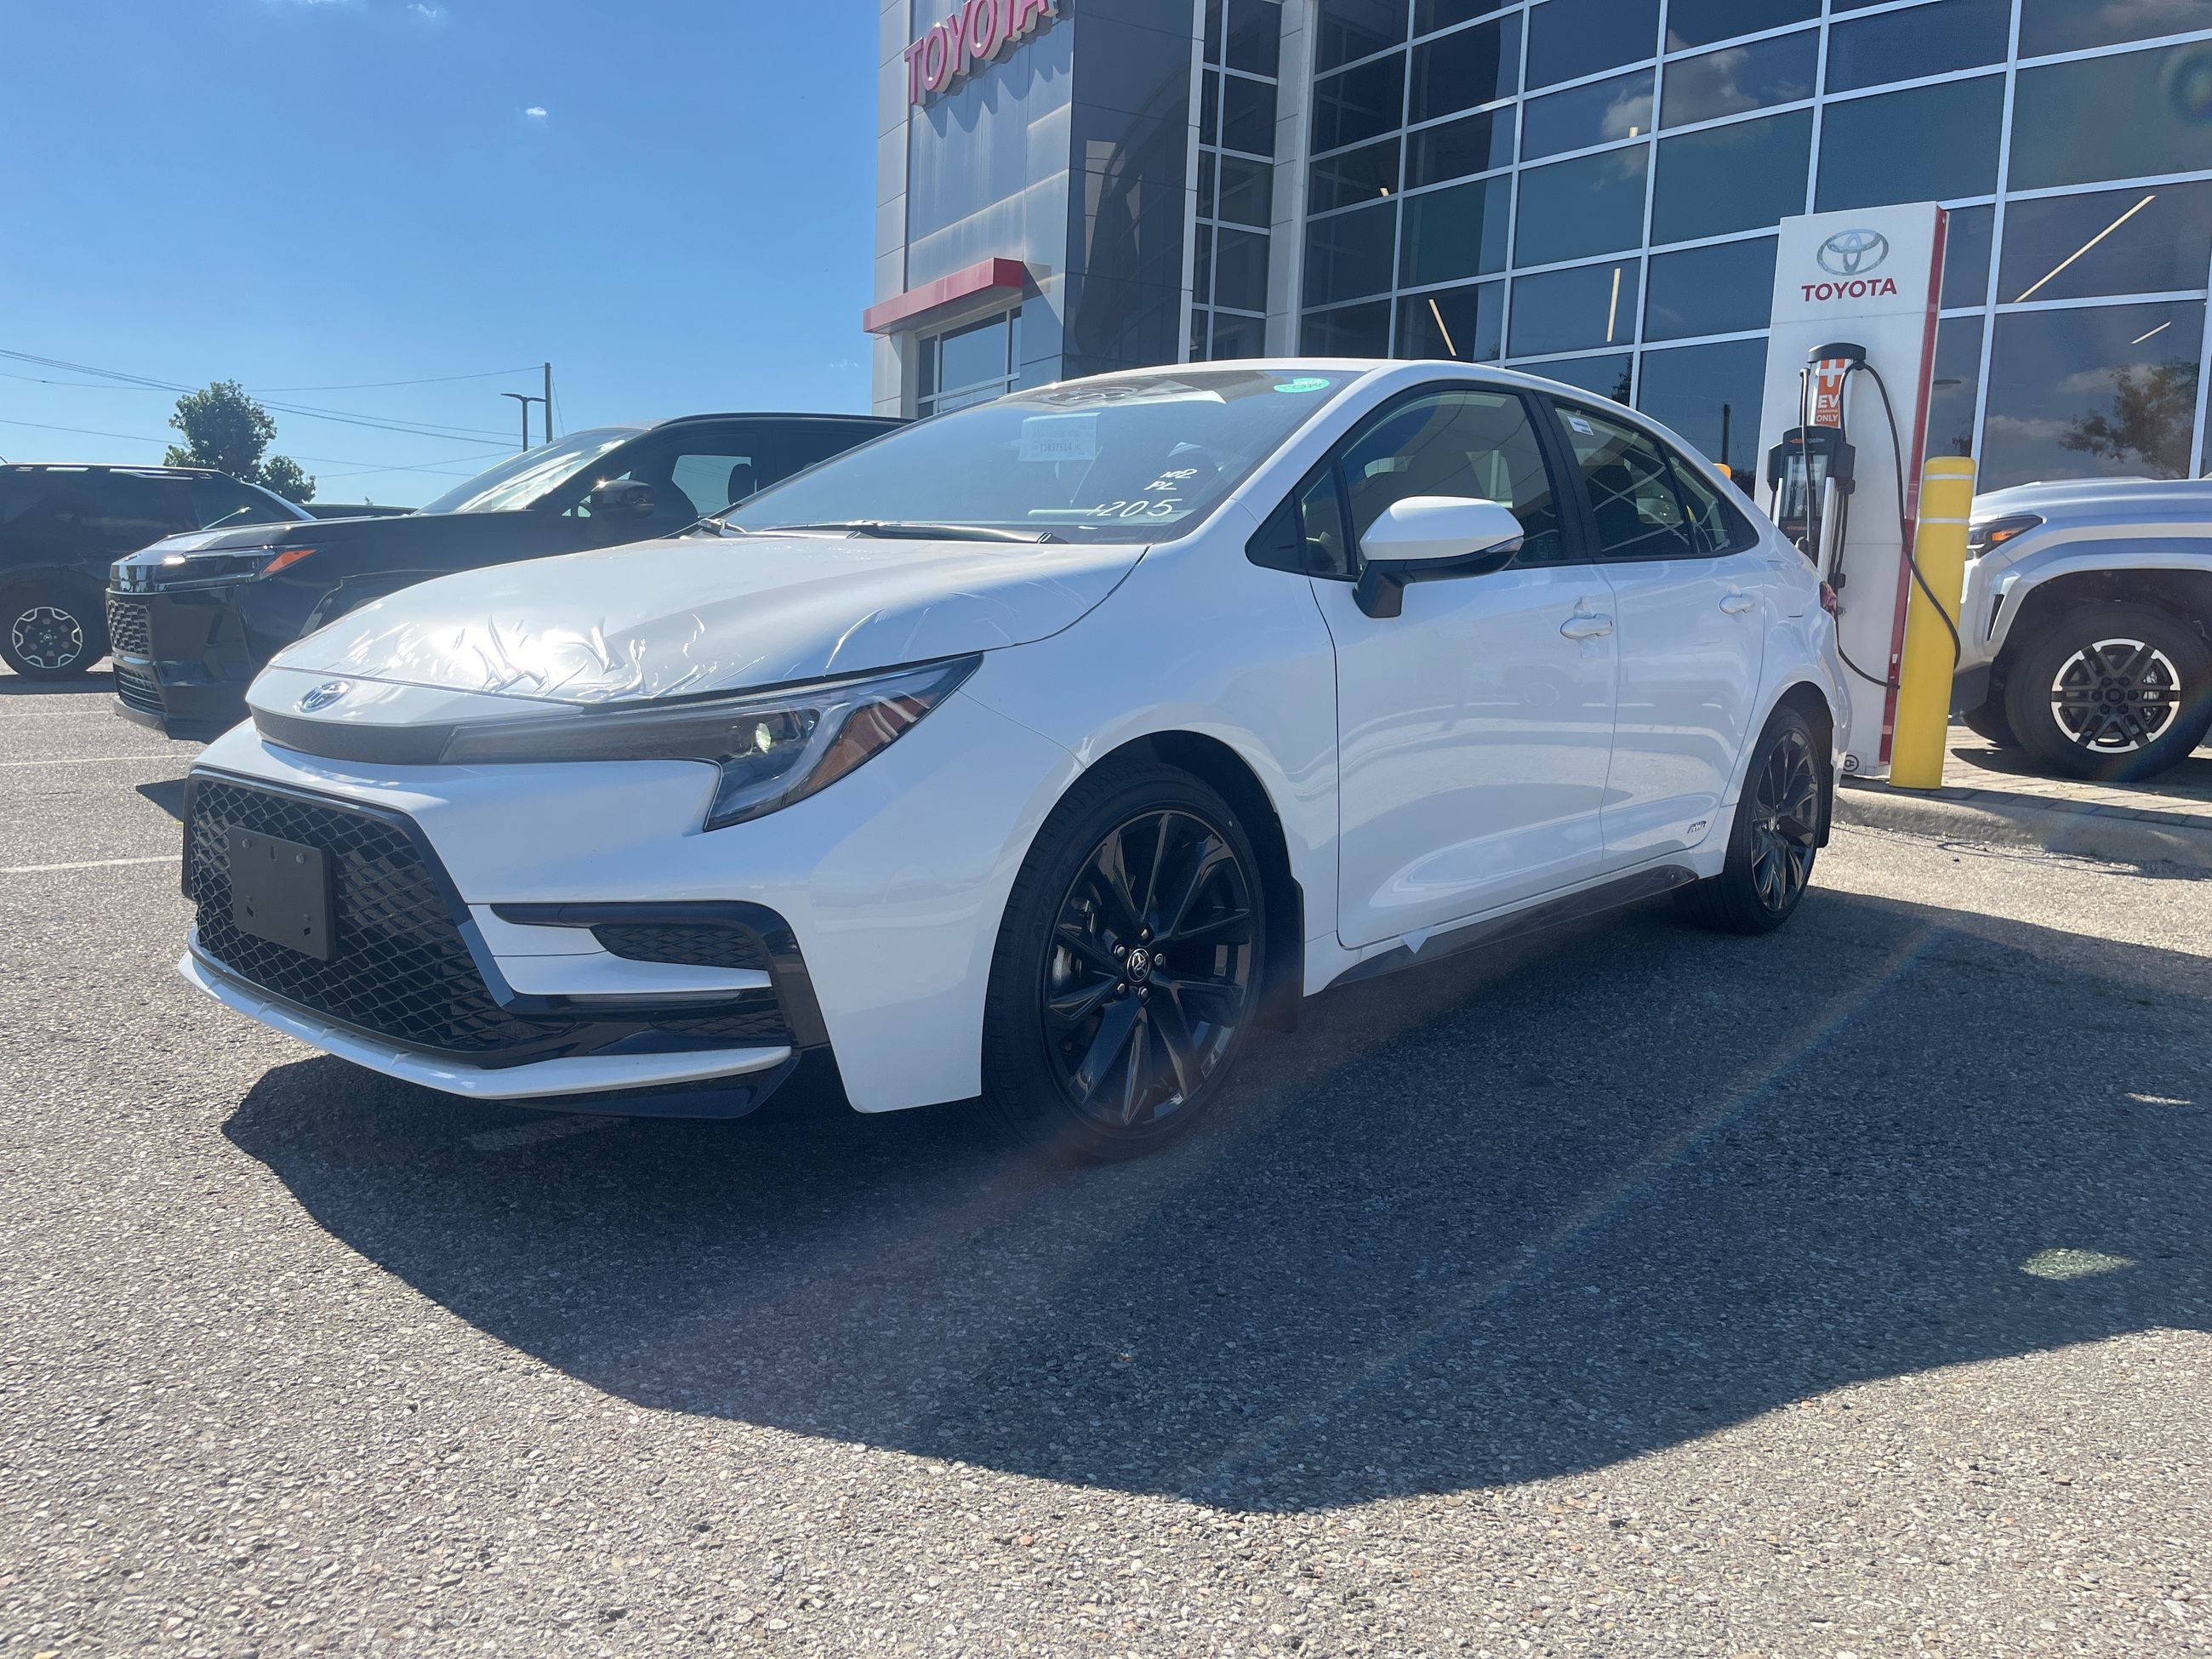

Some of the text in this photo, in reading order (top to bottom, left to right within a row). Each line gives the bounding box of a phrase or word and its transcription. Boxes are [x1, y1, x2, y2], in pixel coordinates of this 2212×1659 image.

[1801, 278, 1897, 302] TOYOTA
[1817, 394, 1839, 408] EV
[1816, 414, 1839, 423] ONLY
[1143, 481, 1177, 490] PL
